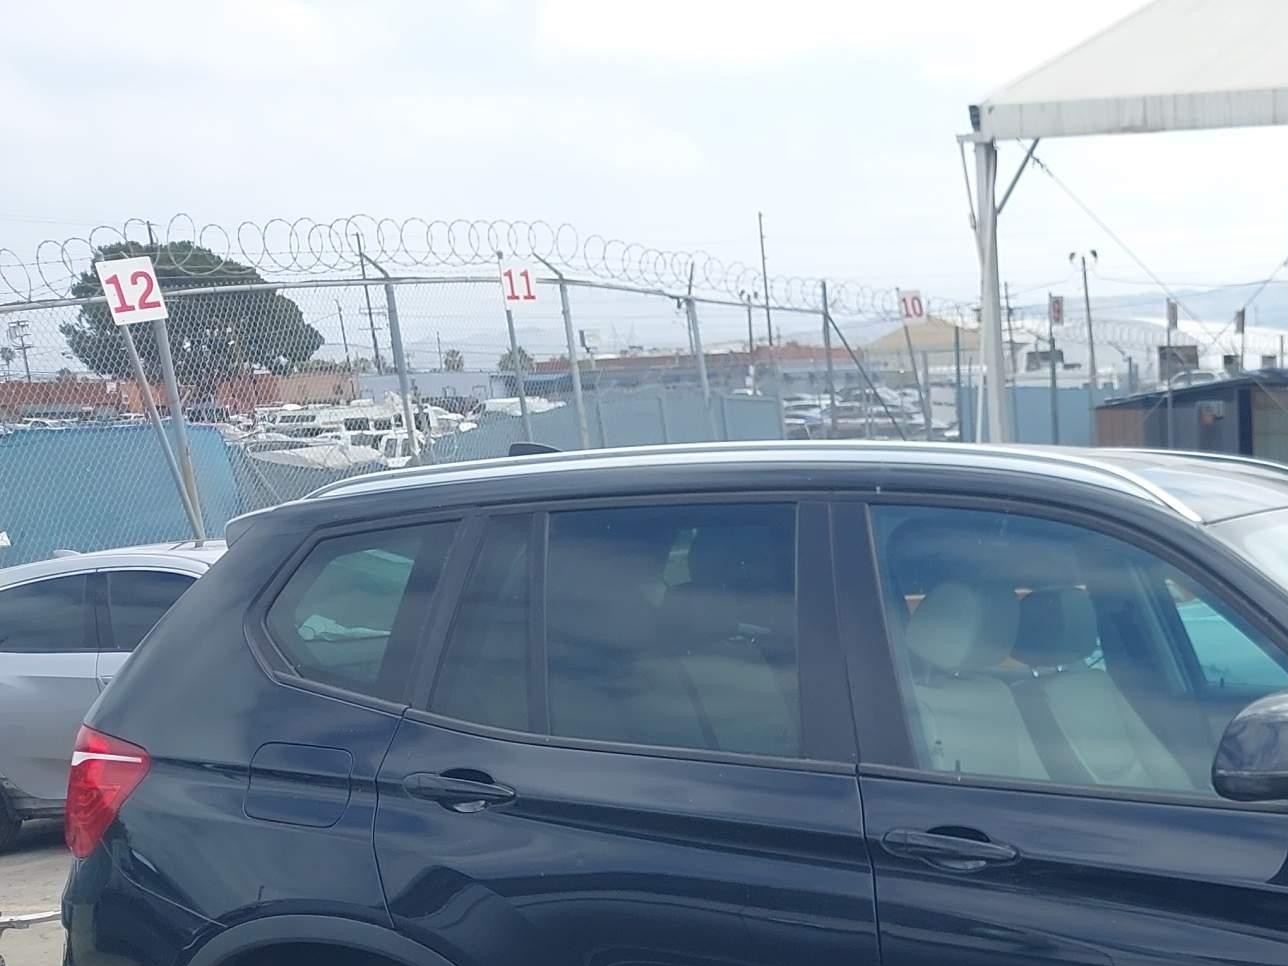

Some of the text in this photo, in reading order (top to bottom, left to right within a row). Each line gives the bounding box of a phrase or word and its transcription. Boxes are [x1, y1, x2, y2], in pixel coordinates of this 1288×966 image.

[105, 271, 161, 313] 12
[503, 269, 536, 300] 11
[902, 296, 923, 318] 10
